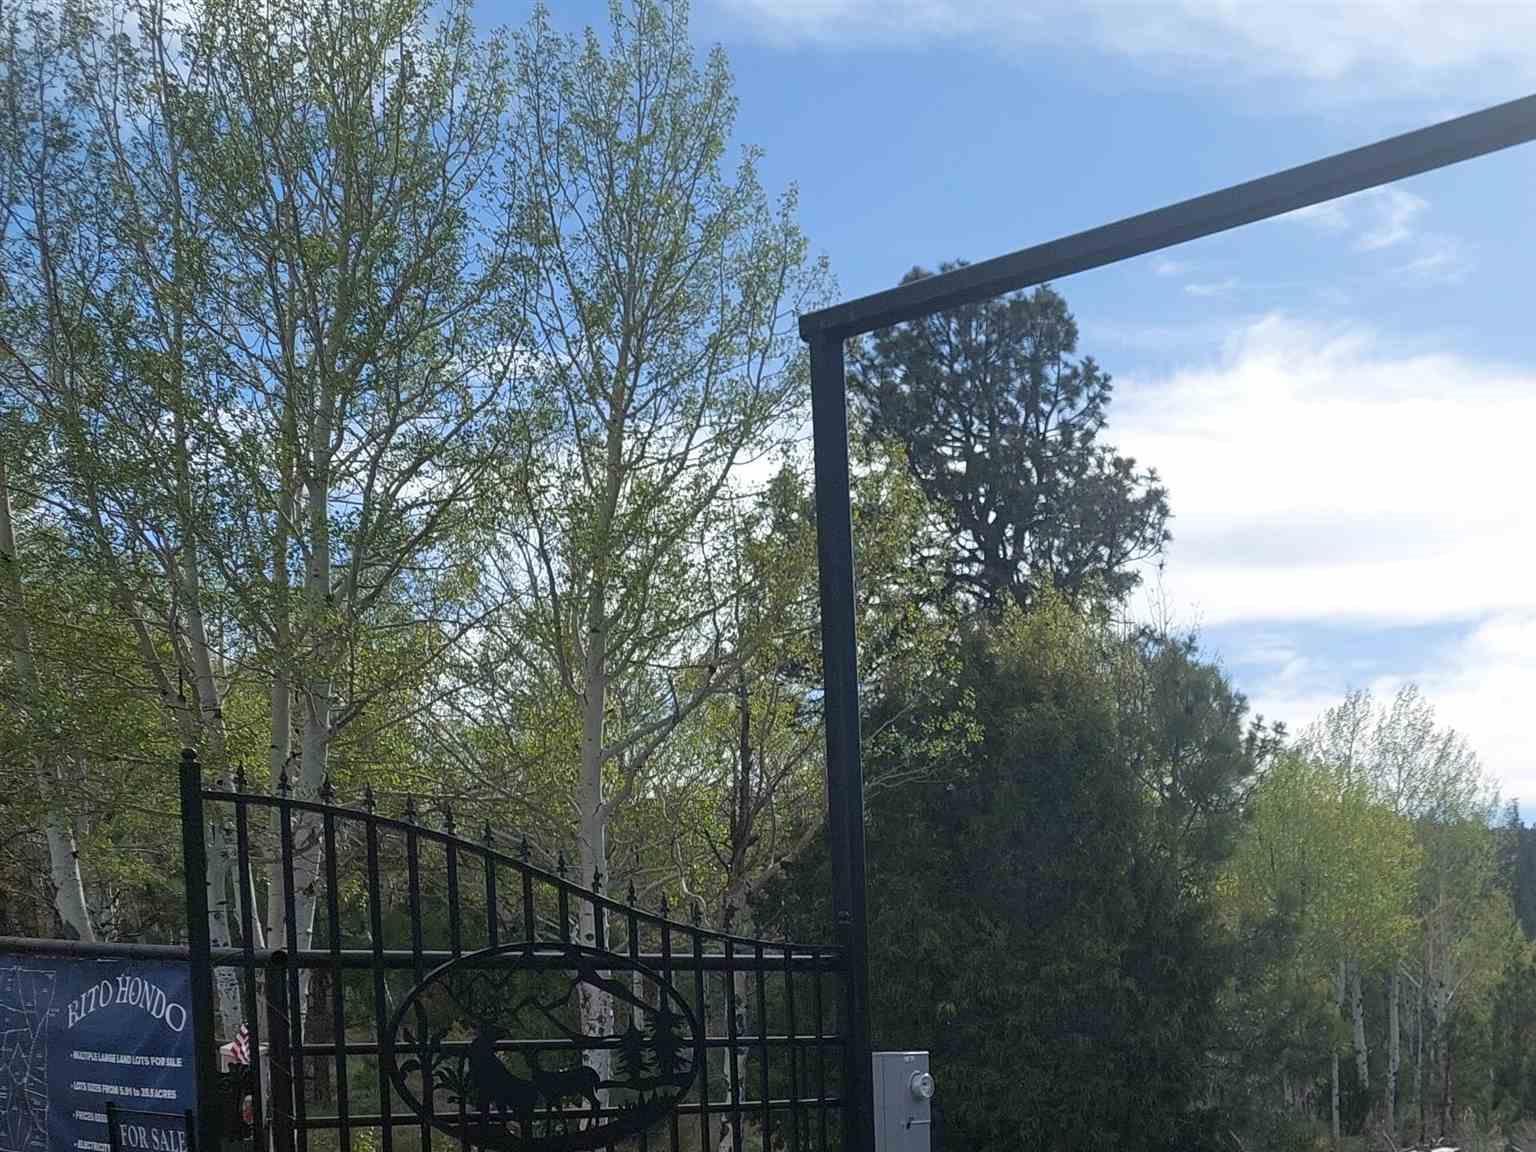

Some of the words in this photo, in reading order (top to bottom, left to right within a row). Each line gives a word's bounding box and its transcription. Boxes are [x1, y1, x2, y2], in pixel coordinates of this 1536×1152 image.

[67, 979, 113, 1029] RITO
[115, 975, 186, 1032] HONDO
[132, 1055, 149, 1066] LOTS
[150, 1056, 165, 1067] FOR
[119, 1123, 150, 1149] FOR
